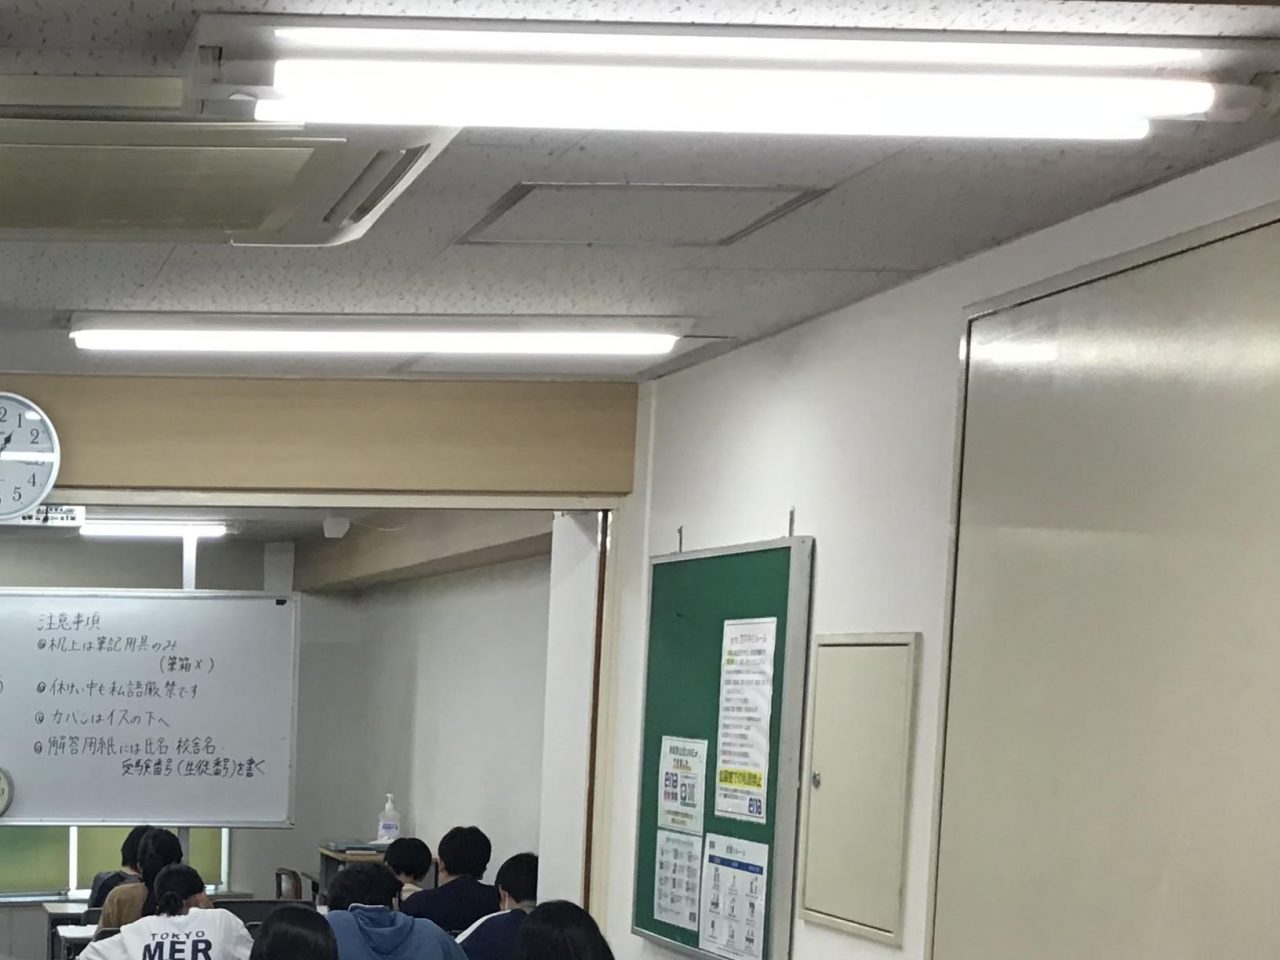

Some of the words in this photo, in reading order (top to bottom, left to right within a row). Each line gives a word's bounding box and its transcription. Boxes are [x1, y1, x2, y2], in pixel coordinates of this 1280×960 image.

[17, 413, 22, 428] 1
[30, 428, 40, 444] 2
[27, 472, 37, 487] 4
[12, 486, 22, 502] 5
[36, 611, 102, 632] 注意事項
[151, 930, 206, 941] TOKYO
